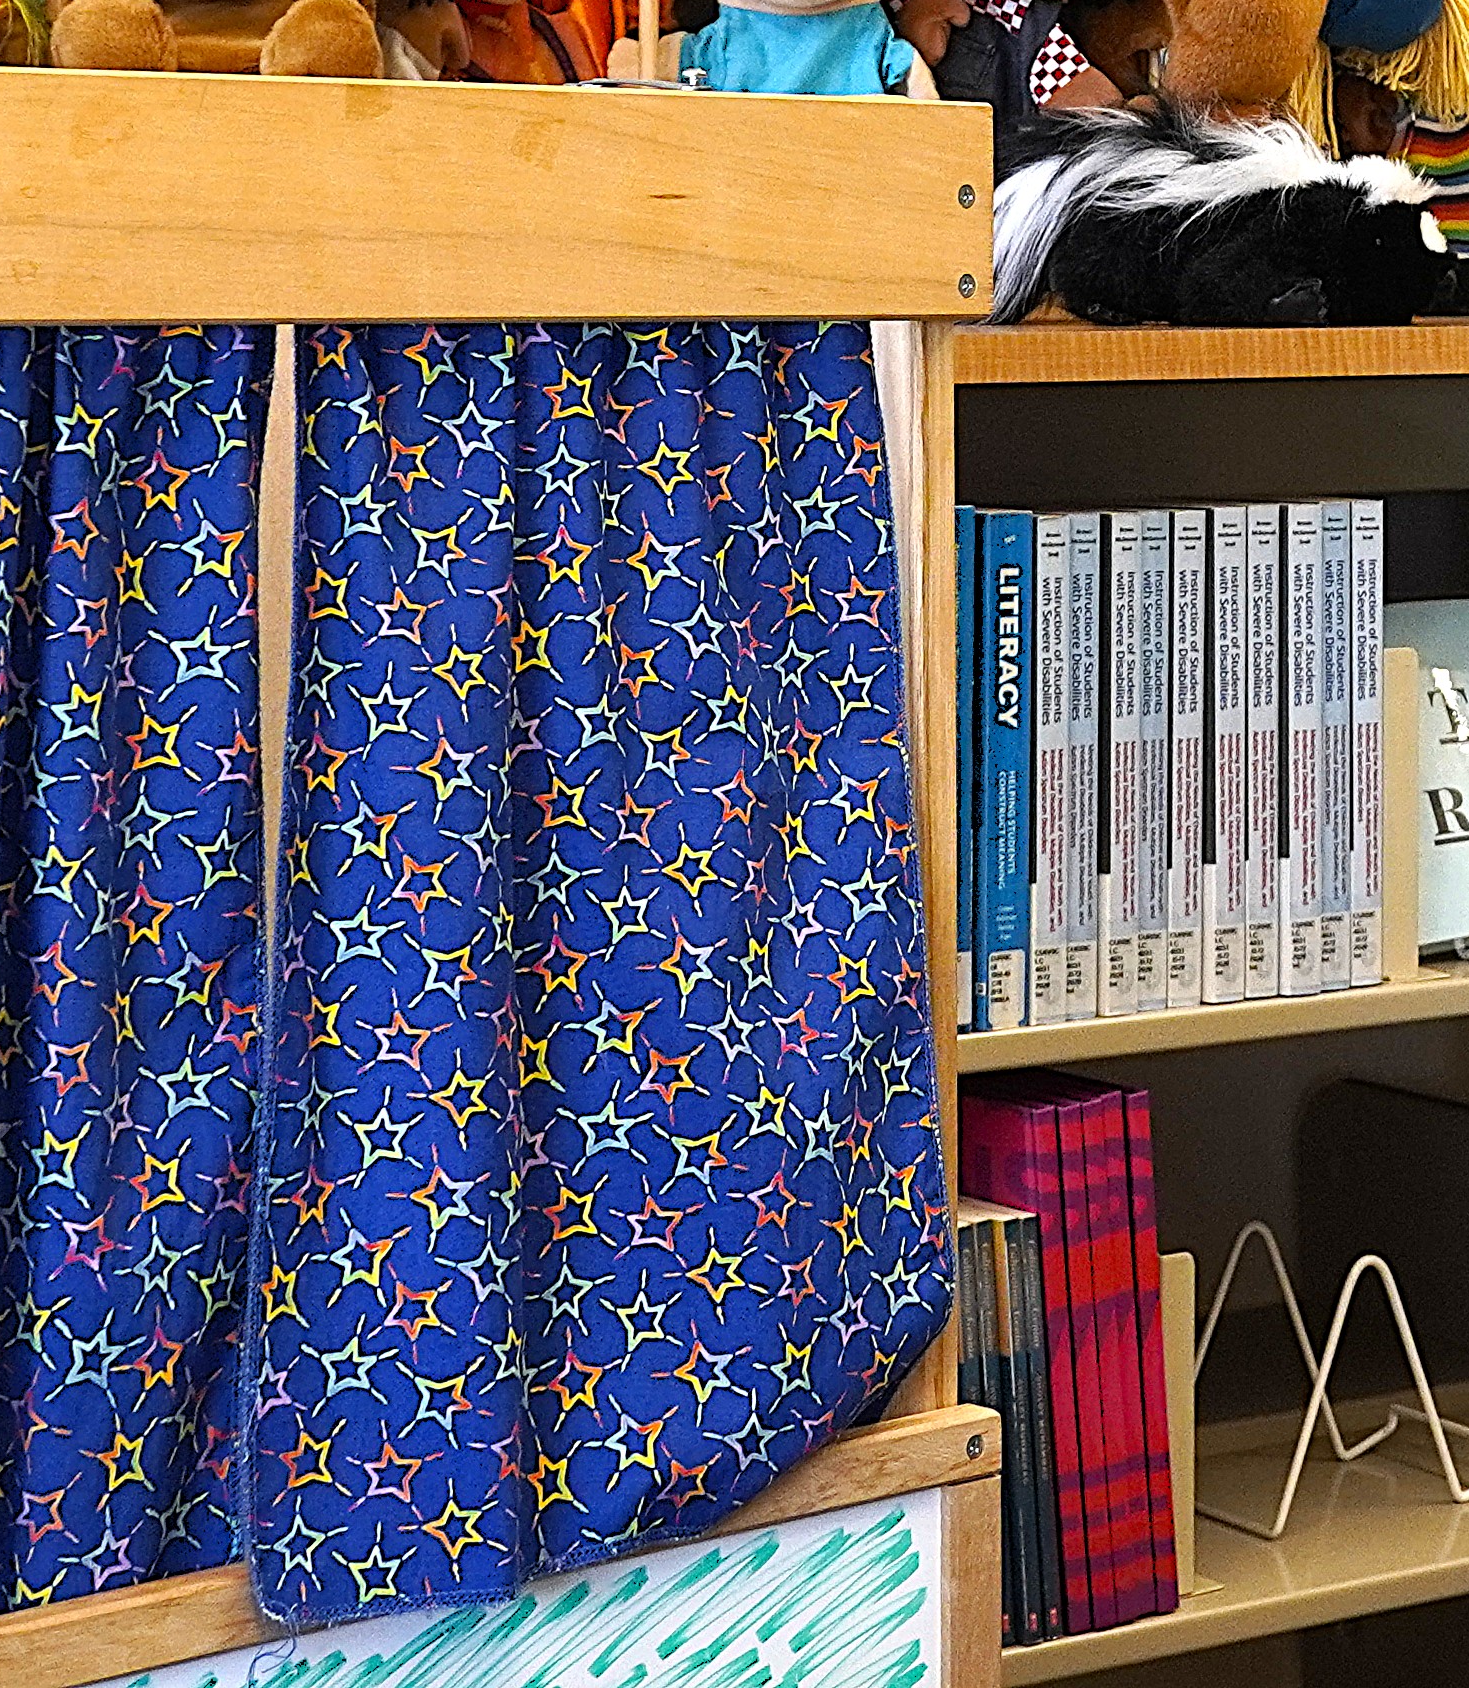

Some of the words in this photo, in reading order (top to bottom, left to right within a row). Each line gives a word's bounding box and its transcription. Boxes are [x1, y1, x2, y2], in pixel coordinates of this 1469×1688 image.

[1042, 577, 1052, 606] with
[1054, 577, 1063, 646] Instruction
[1072, 573, 1082, 602] with
[1084, 574, 1094, 643] Instruction
[998, 567, 1020, 728] LITERACY
[1042, 610, 1052, 653] Severe
[1072, 606, 1082, 649] Severe
[1042, 658, 1052, 726] Disabilities
[1054, 665, 1063, 724] Students
[1072, 654, 1082, 722] Disabilities
[1084, 663, 1094, 719] Students
